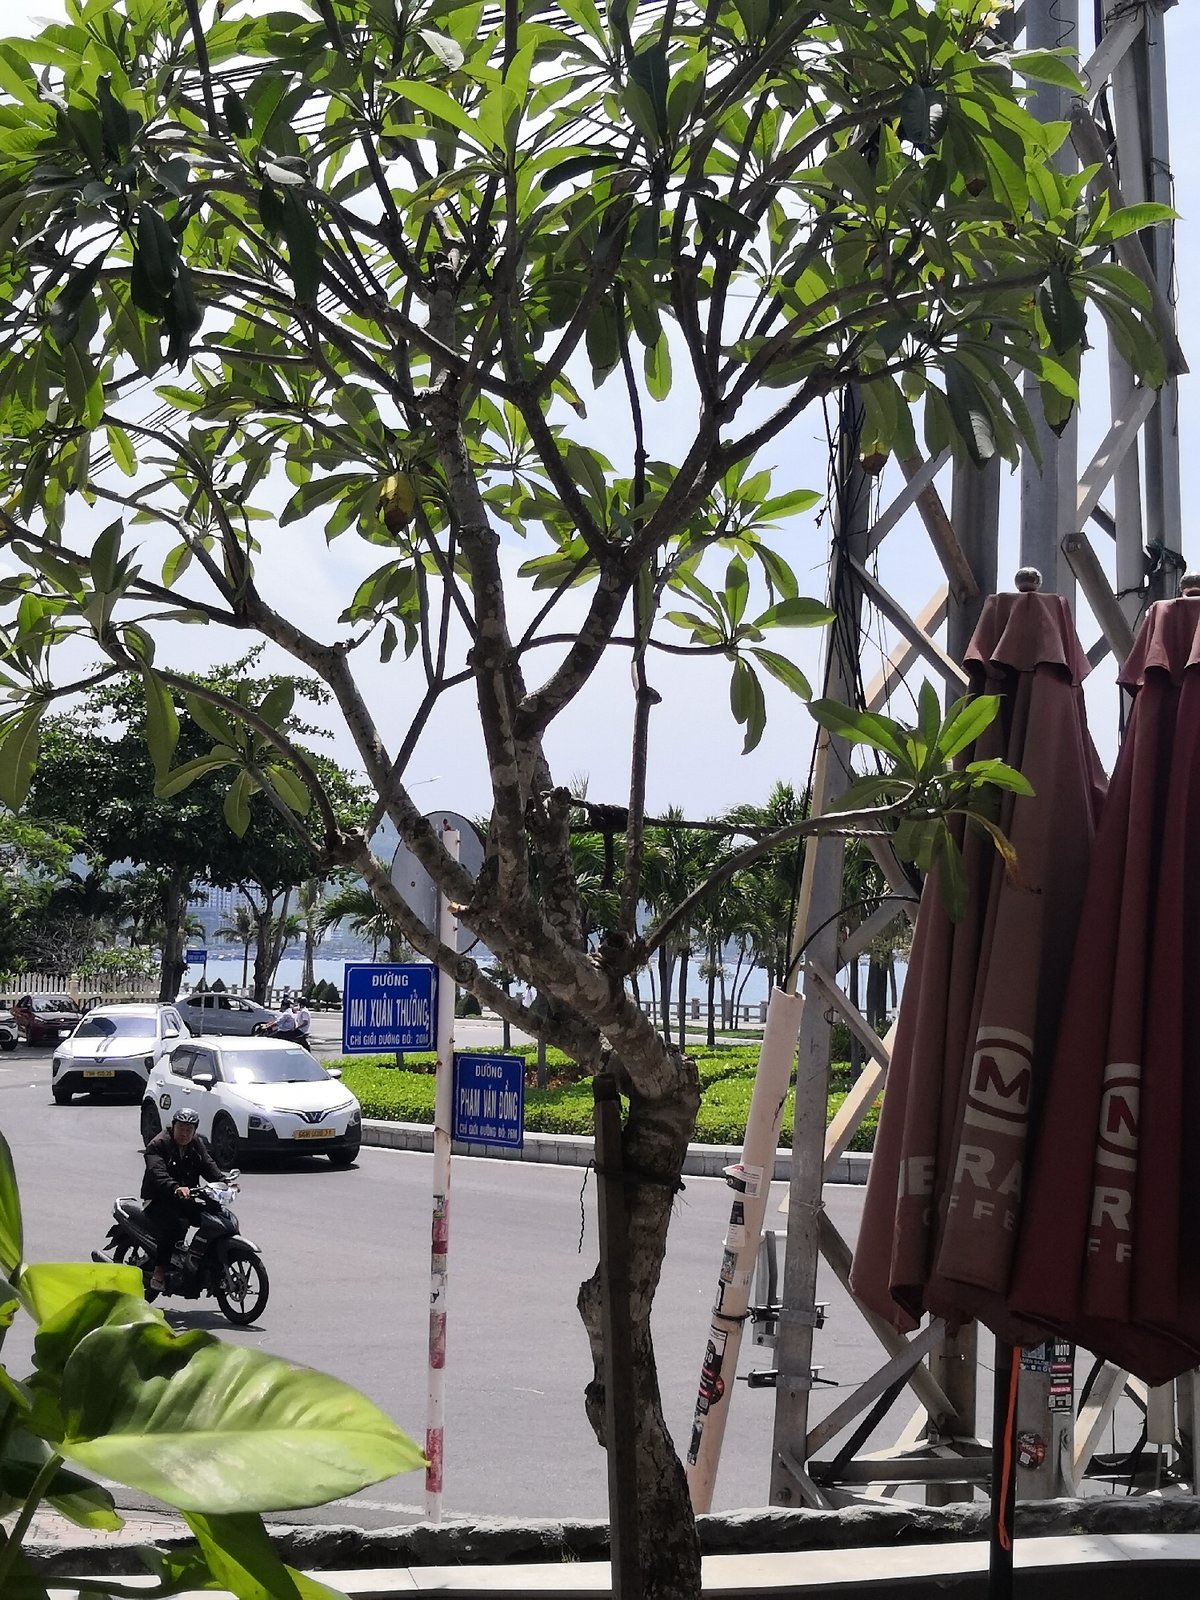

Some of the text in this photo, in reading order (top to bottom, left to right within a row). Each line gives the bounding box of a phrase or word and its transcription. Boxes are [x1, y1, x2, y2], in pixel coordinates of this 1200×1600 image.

[372, 971, 409, 987] ĐƯỜNG
[350, 988, 428, 1028] MAI XUÂN THƯỞNG
[475, 1063, 503, 1078] ĐƯỜNG
[460, 1079, 518, 1121] PHẠM VĂN ĐỒNG
